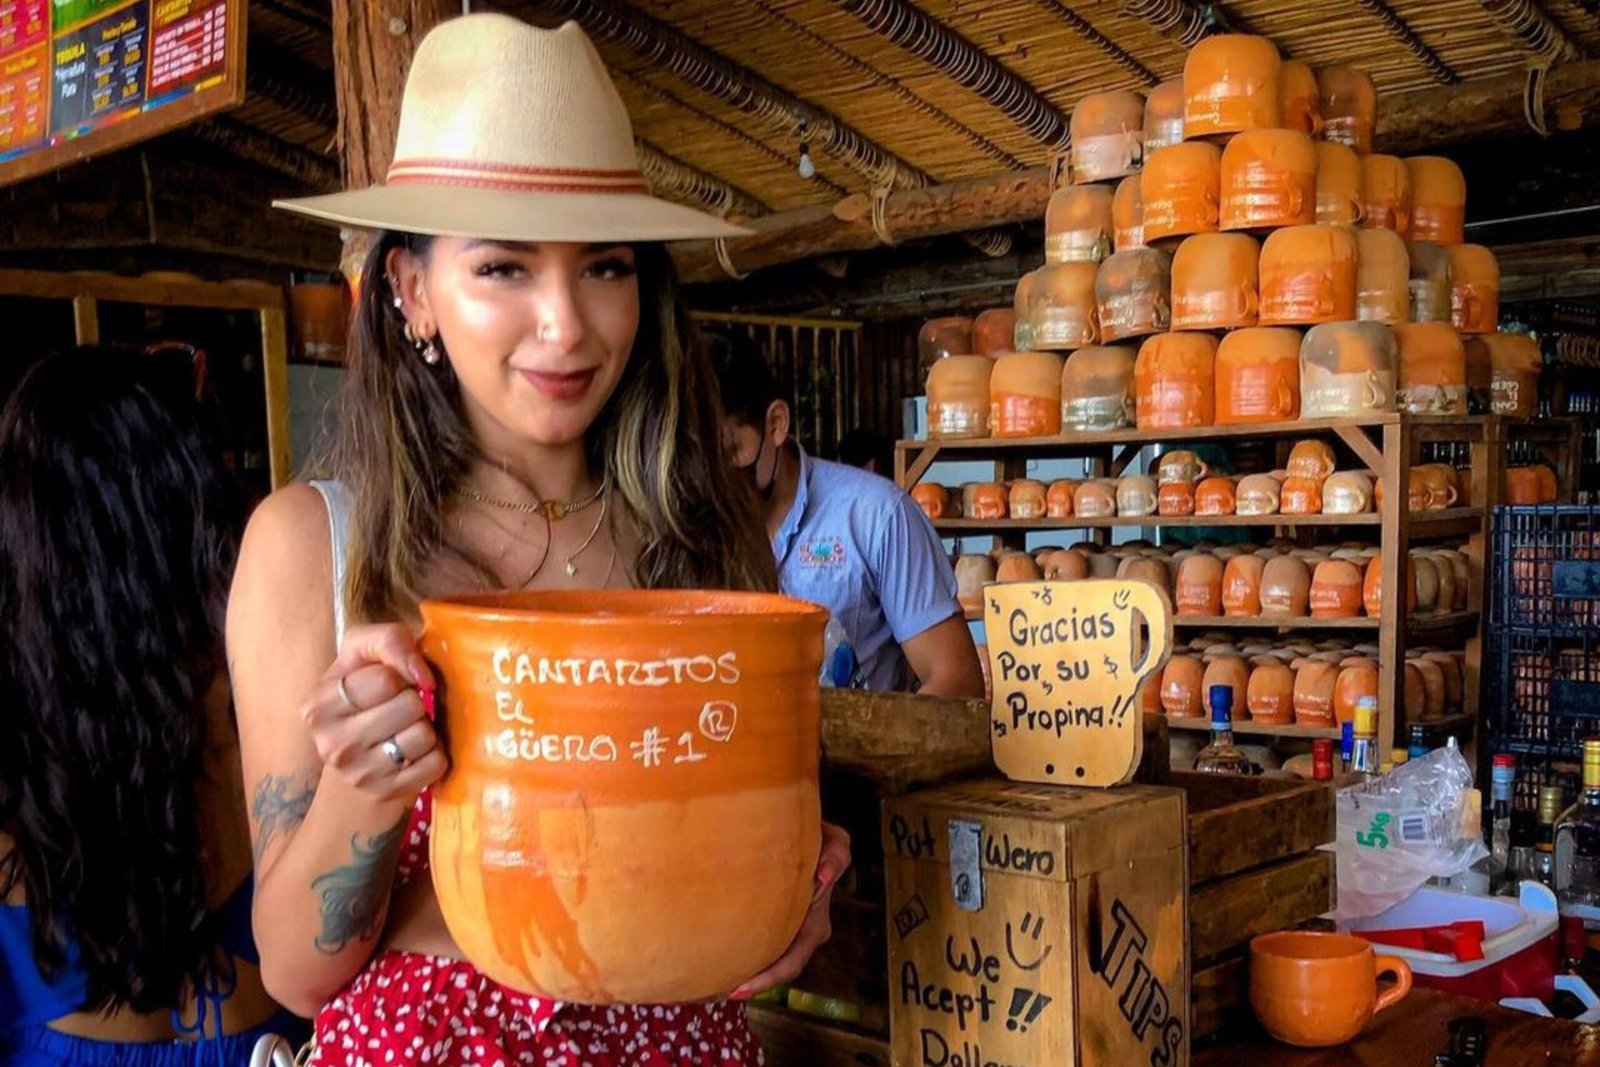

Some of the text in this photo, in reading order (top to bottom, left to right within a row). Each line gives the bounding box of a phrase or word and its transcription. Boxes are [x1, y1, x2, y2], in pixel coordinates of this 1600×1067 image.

[1009, 607, 1115, 646] Gracias
[492, 647, 741, 687] CANTARITOS
[997, 651, 1090, 681] Por su
[495, 690, 535, 724] EL
[945, 934, 1000, 983] We
[901, 959, 996, 1031] Acept
[1101, 898, 1182, 1067] TIPS
